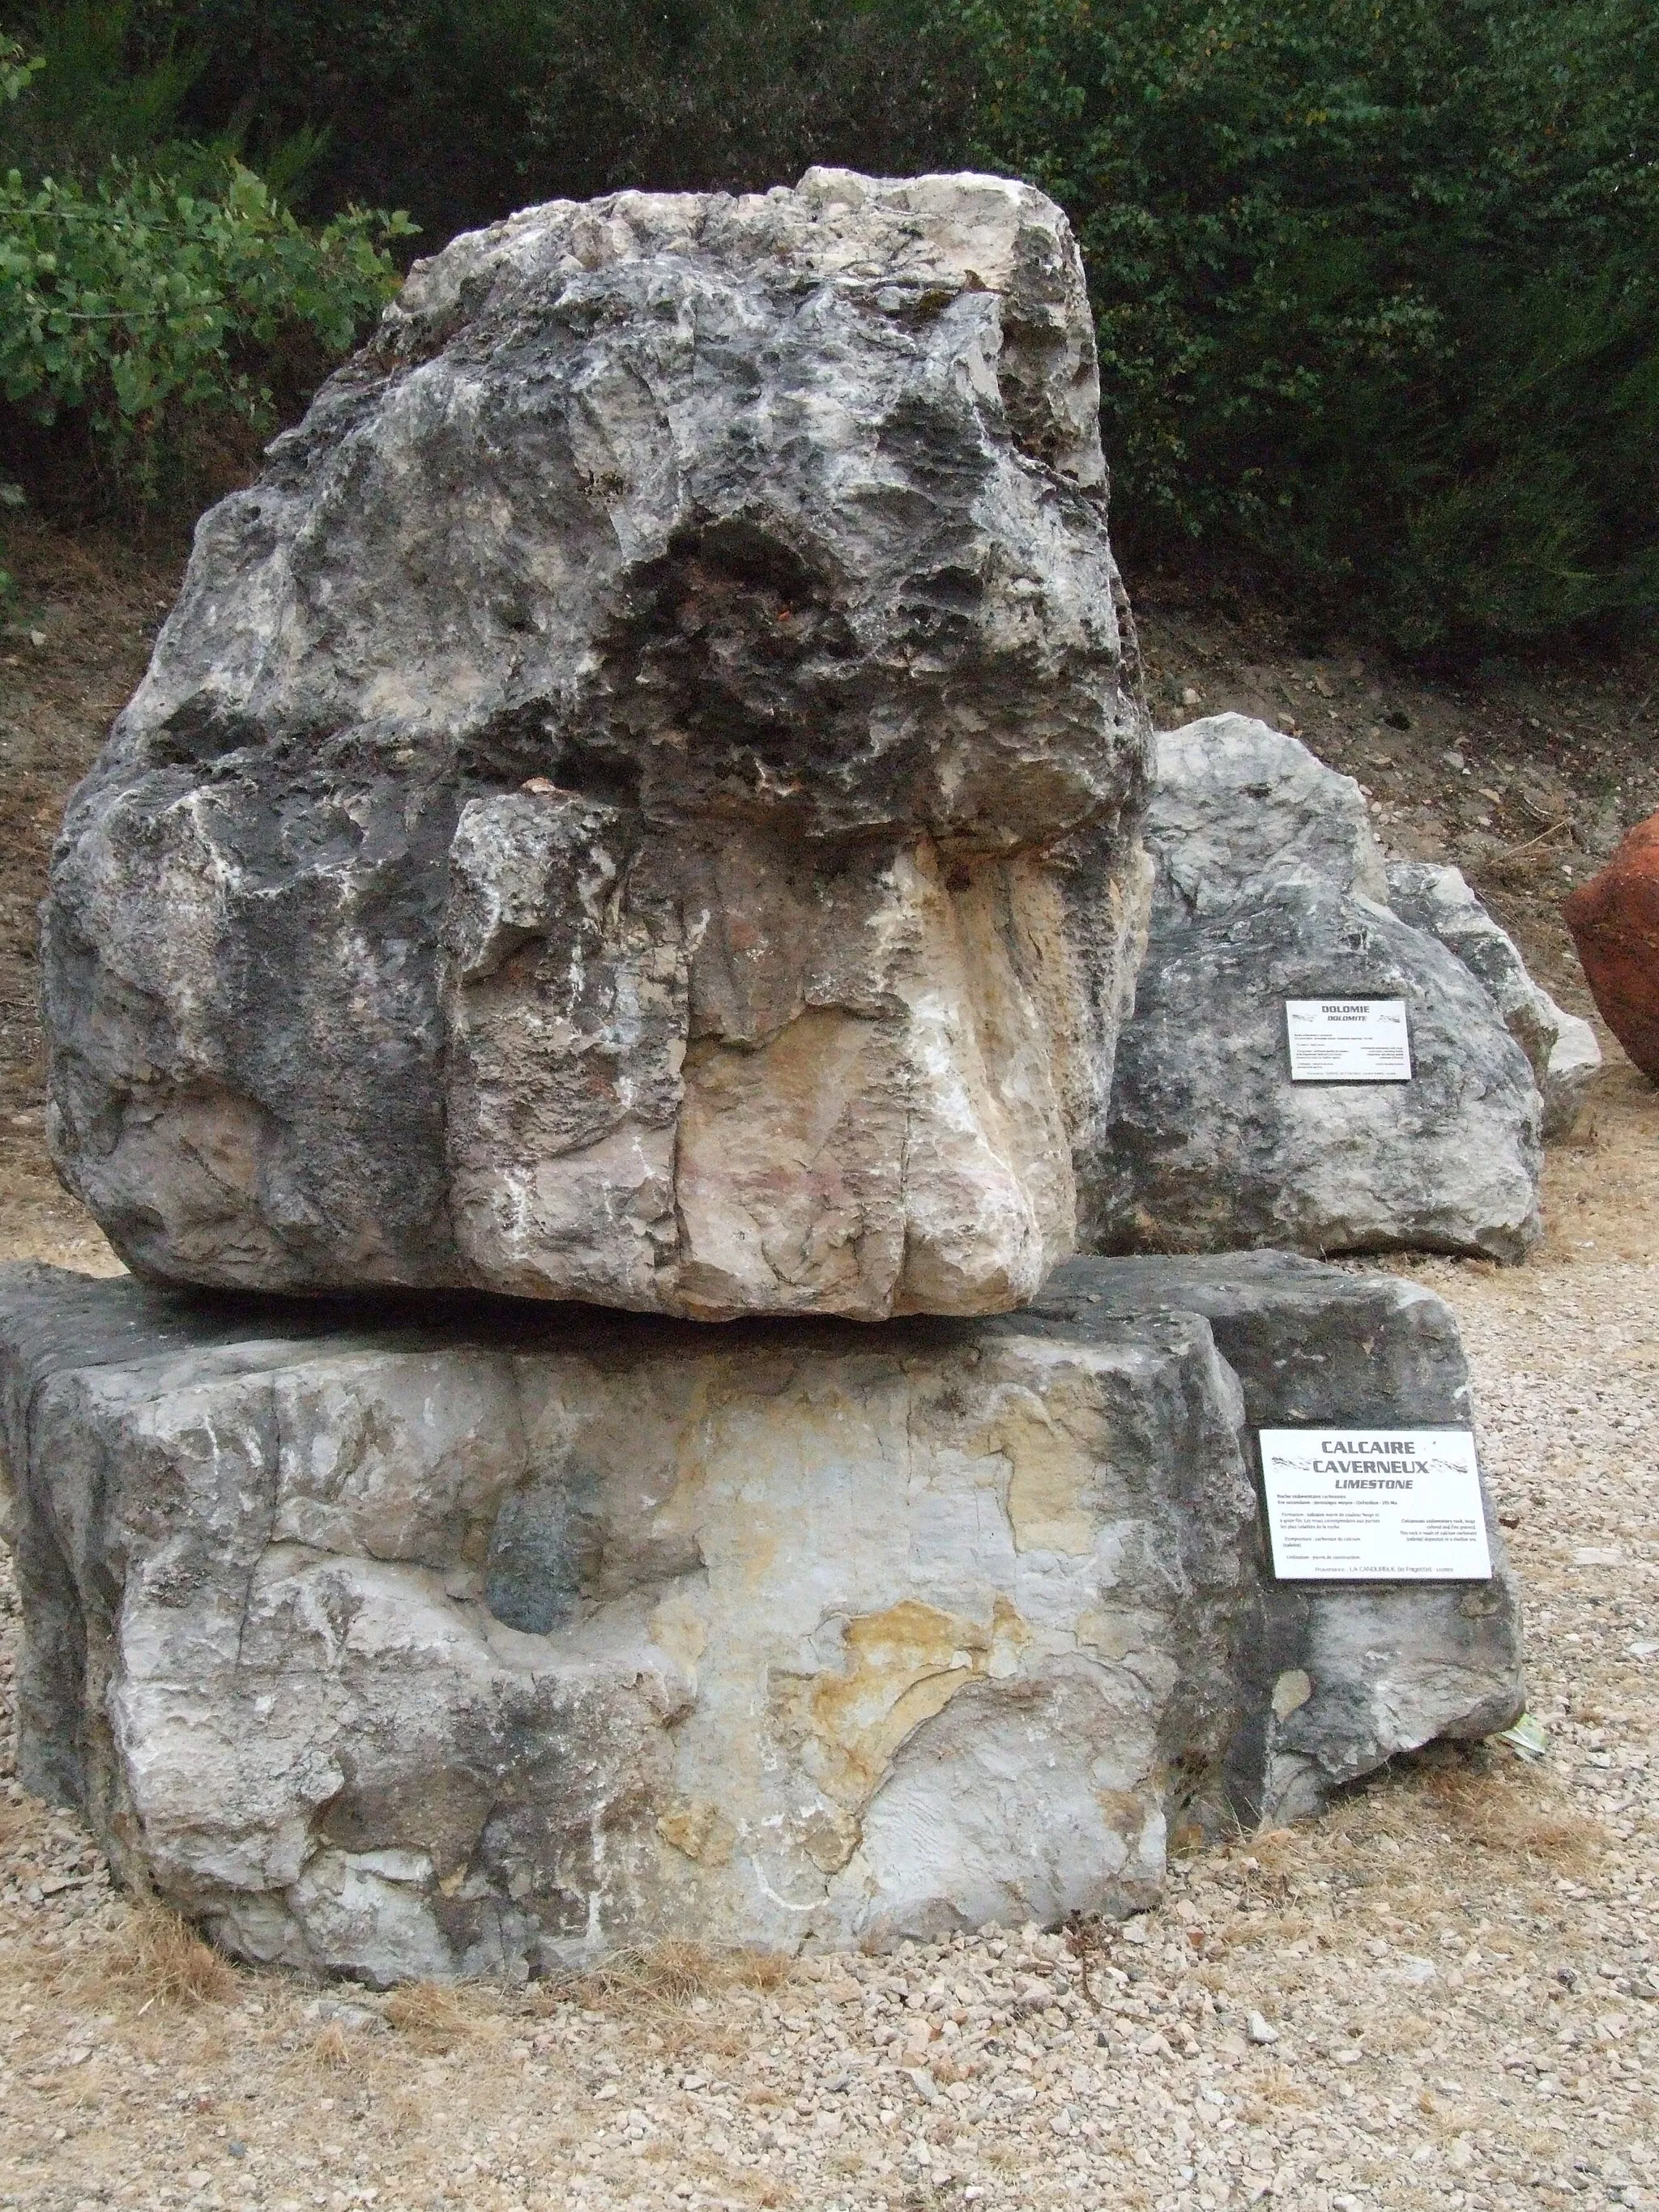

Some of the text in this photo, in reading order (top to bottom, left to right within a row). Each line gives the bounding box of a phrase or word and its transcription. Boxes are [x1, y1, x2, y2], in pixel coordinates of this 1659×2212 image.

[1321, 1441, 1415, 1454] CALCAIRE
[1313, 1460, 1429, 1473] CAVERNEUX
[1335, 1480, 1413, 1490] LIMESTONE
